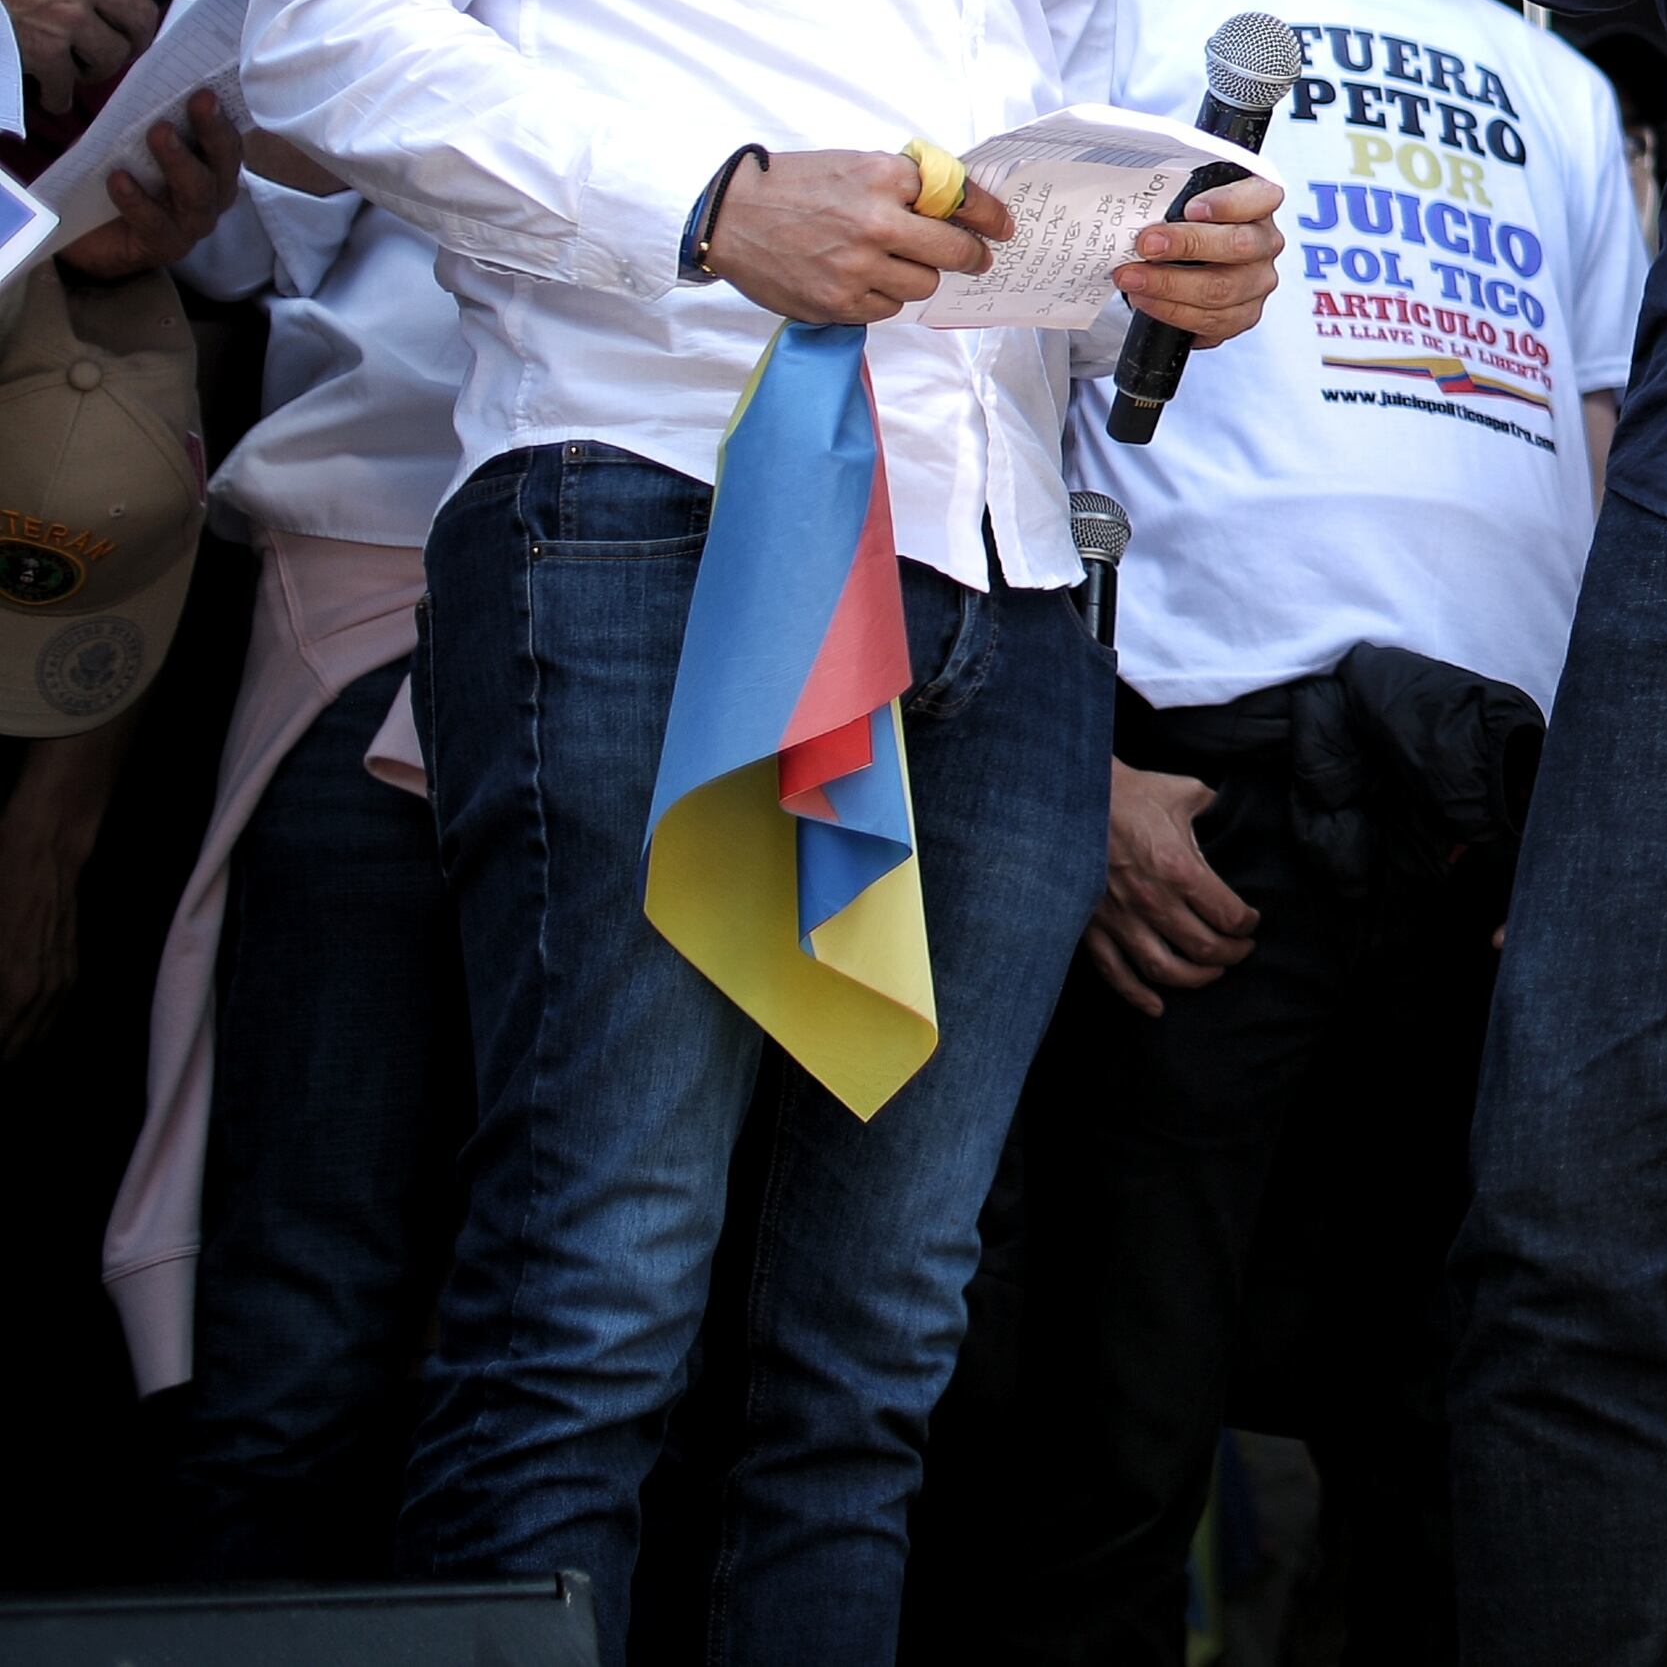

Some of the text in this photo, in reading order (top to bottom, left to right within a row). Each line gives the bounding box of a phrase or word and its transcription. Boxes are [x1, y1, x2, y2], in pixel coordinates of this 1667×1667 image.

[1289, 25, 1520, 121] FUERA
[1289, 77, 1527, 167] PETRO
[1345, 133, 1493, 207] POR
[1297, 182, 1543, 278] JUICIO
[1316, 322, 1343, 339] LA
[1350, 325, 1415, 346] LLAVE
[1450, 342, 1473, 359] LA
[1503, 329, 1549, 367] 109
[0, 509, 117, 561] TERAN
